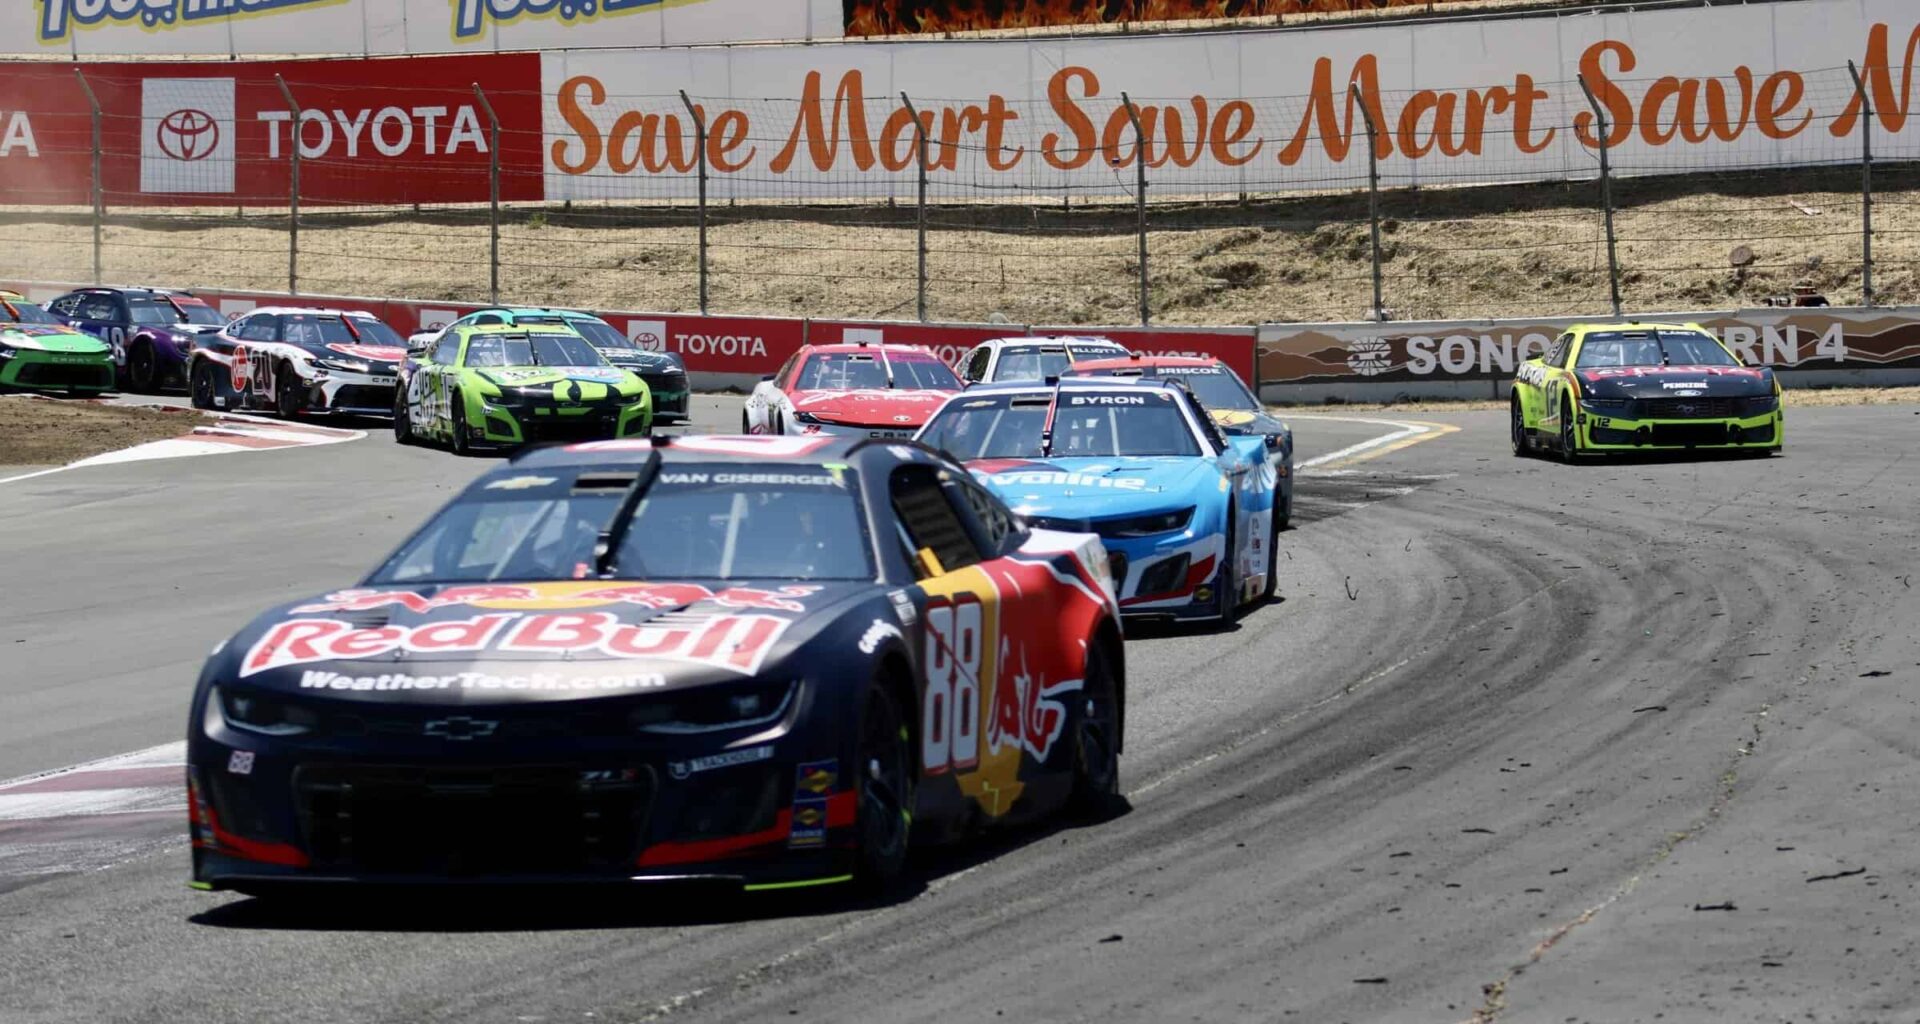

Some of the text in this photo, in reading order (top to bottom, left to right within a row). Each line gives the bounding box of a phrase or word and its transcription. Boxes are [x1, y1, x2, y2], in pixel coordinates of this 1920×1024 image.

[551, 75, 756, 175] Save
[769, 69, 1026, 174] Mart
[1041, 65, 1263, 171] Save
[1277, 53, 1556, 166] Mart
[1574, 40, 1813, 150] Save
[257, 106, 489, 159] TOYOTA
[675, 333, 768, 357] TOYOTA
[1406, 333, 1553, 374] SONO
[1815, 323, 1848, 363] 4
[1156, 366, 1221, 375] BRISCOE
[1662, 382, 1710, 390] PENNZOIL
[1071, 396, 1145, 405] BYRON
[1595, 417, 1612, 428] 12
[659, 473, 846, 489] VAN GISBERGEN
[241, 614, 511, 677] Red
[505, 611, 794, 677] Bull
[299, 669, 665, 692] WeatherTech.com
[922, 590, 983, 776] 88
